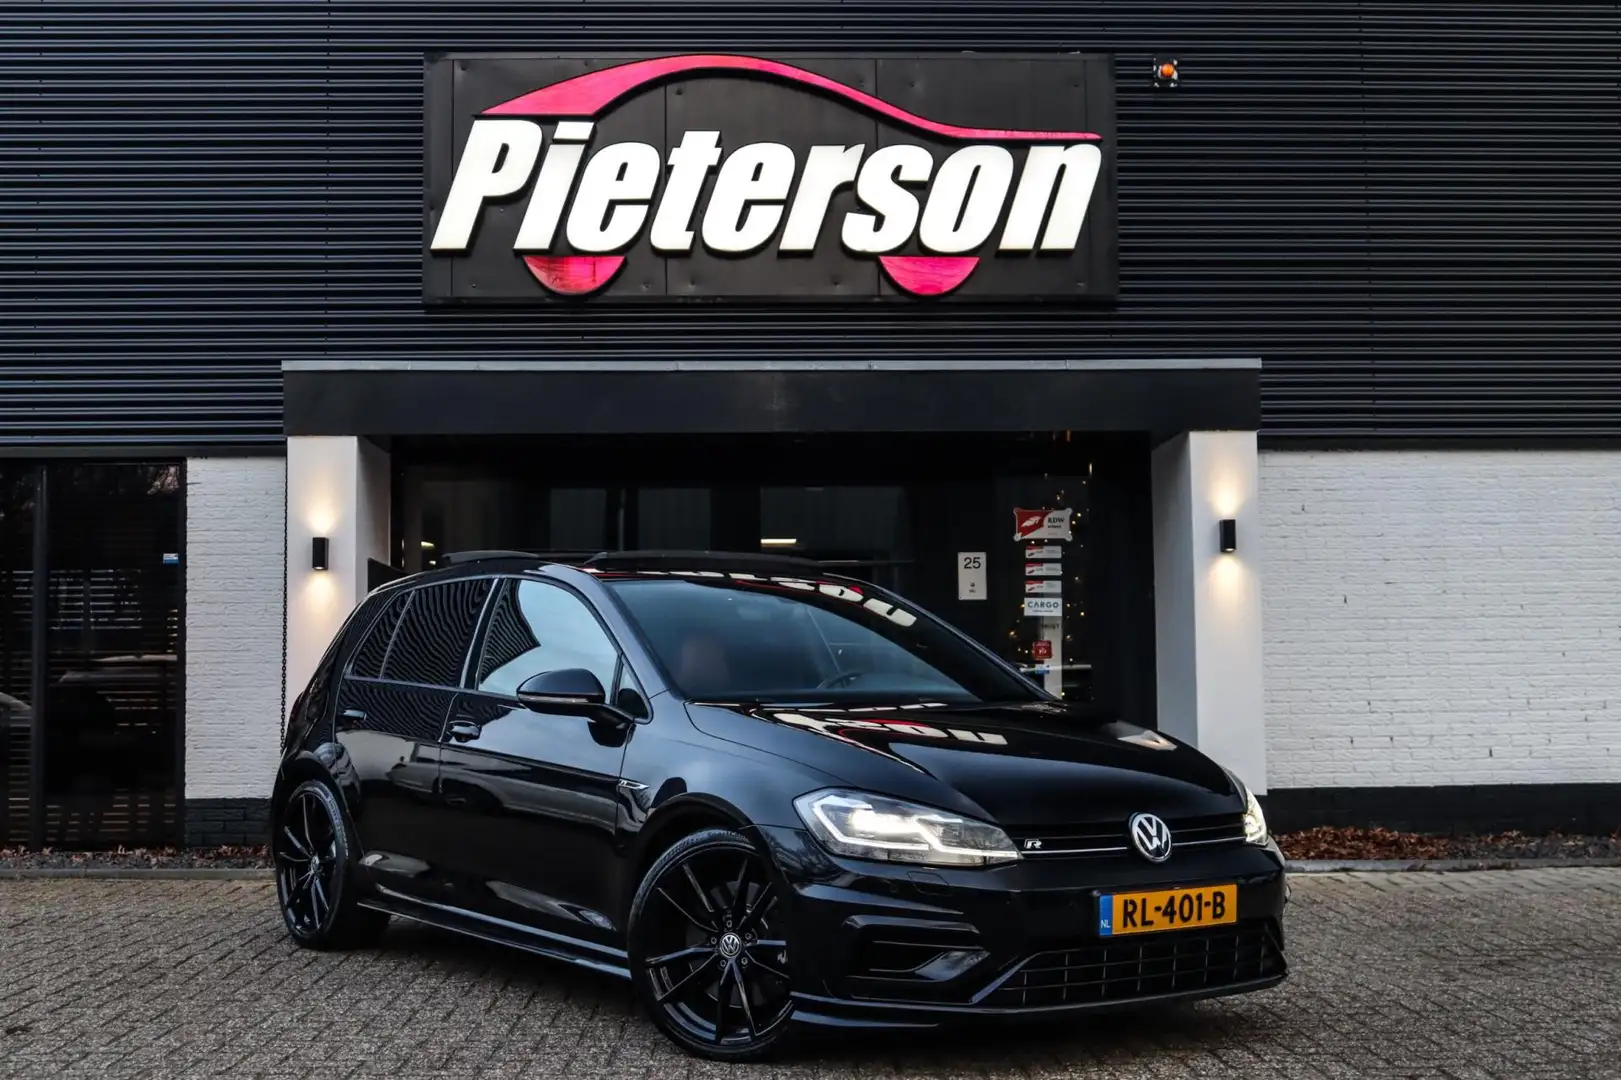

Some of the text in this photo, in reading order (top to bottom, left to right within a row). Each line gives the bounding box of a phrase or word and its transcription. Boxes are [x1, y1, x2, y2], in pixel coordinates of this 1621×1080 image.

[430, 119, 1102, 252] Pieterson
[963, 556, 981, 570] 25
[1027, 600, 1060, 609] CARGO
[1122, 890, 1226, 929] RL-401-B
[1100, 919, 1111, 929] NL
